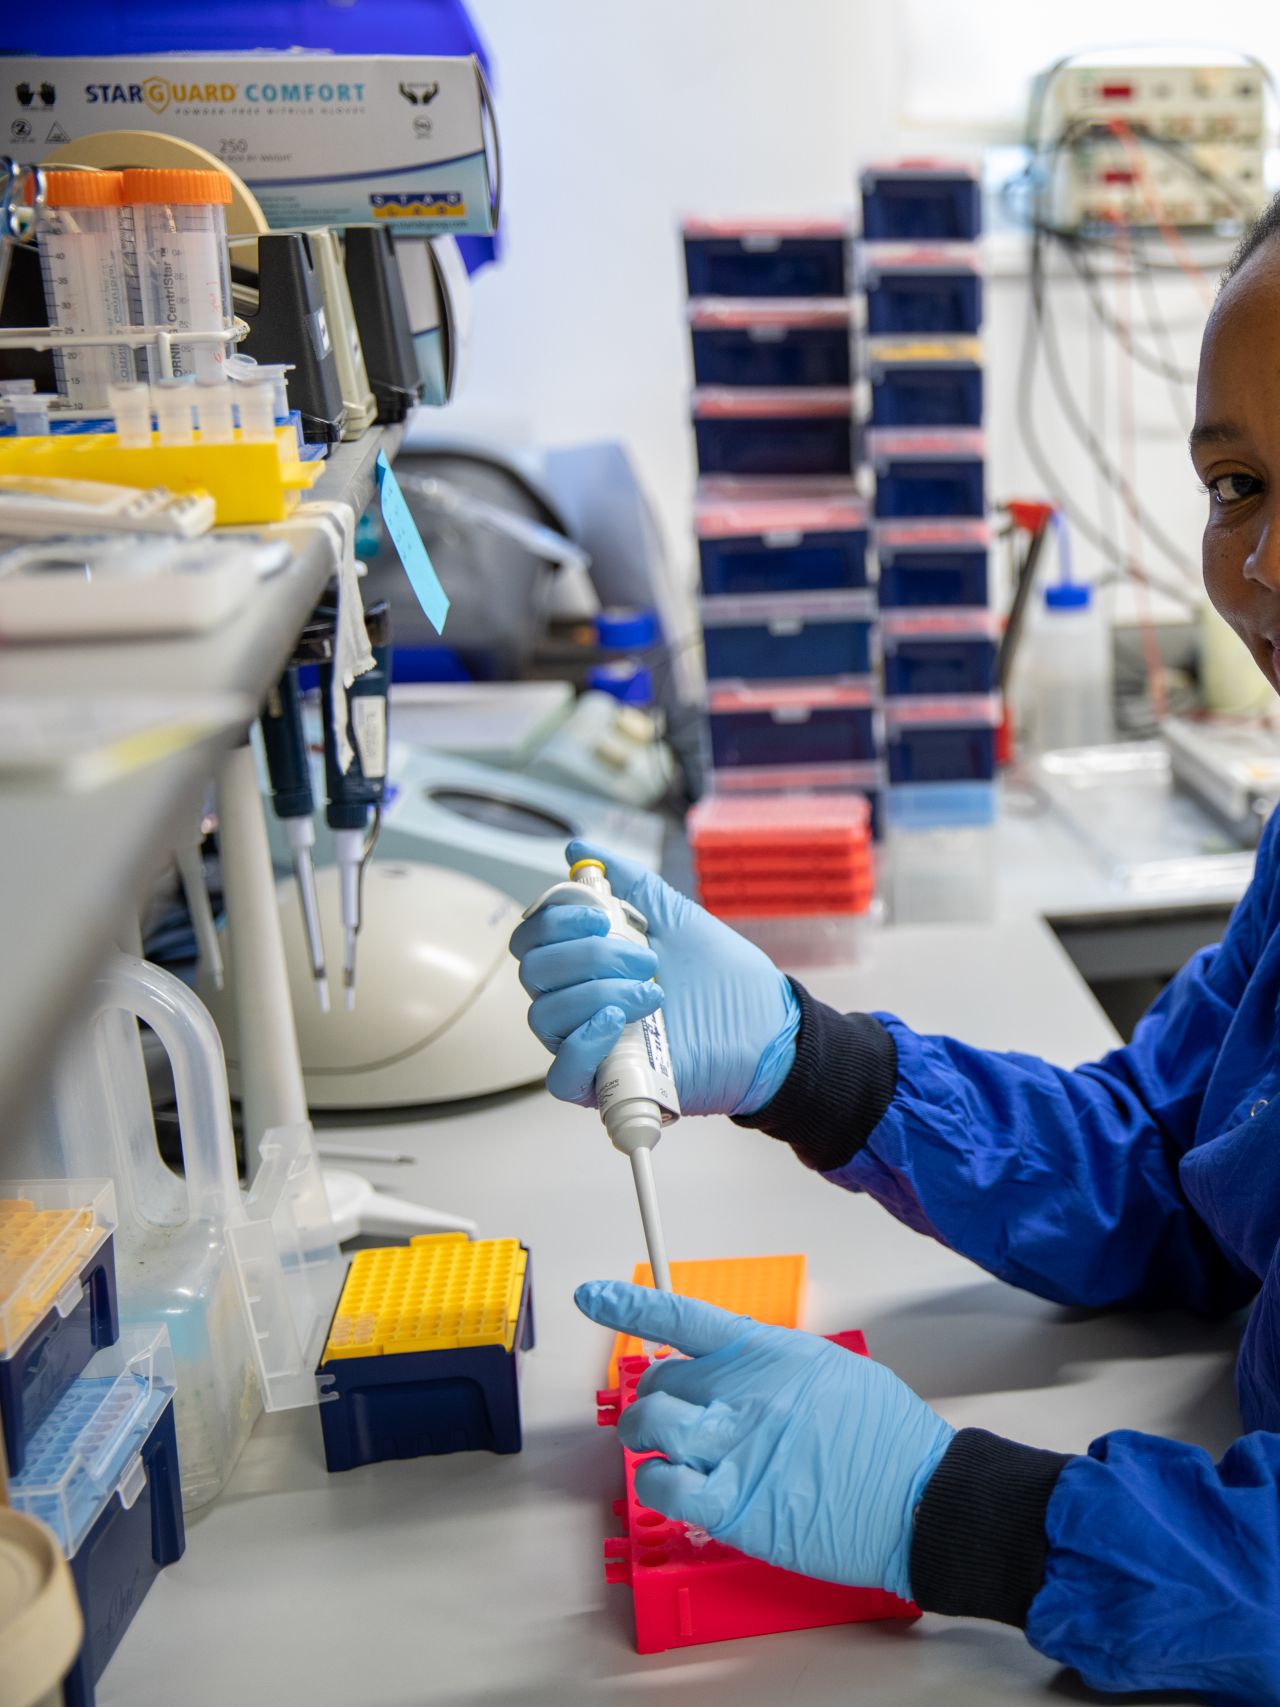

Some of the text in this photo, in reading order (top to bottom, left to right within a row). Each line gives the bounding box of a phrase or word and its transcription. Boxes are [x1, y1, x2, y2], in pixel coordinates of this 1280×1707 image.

[244, 83, 366, 102] COMFORT
[219, 138, 248, 154] 250
[65, 326, 74, 335] 25
[67, 352, 77, 360] 20
[71, 377, 81, 385] 15
[73, 402, 83, 410] 10
